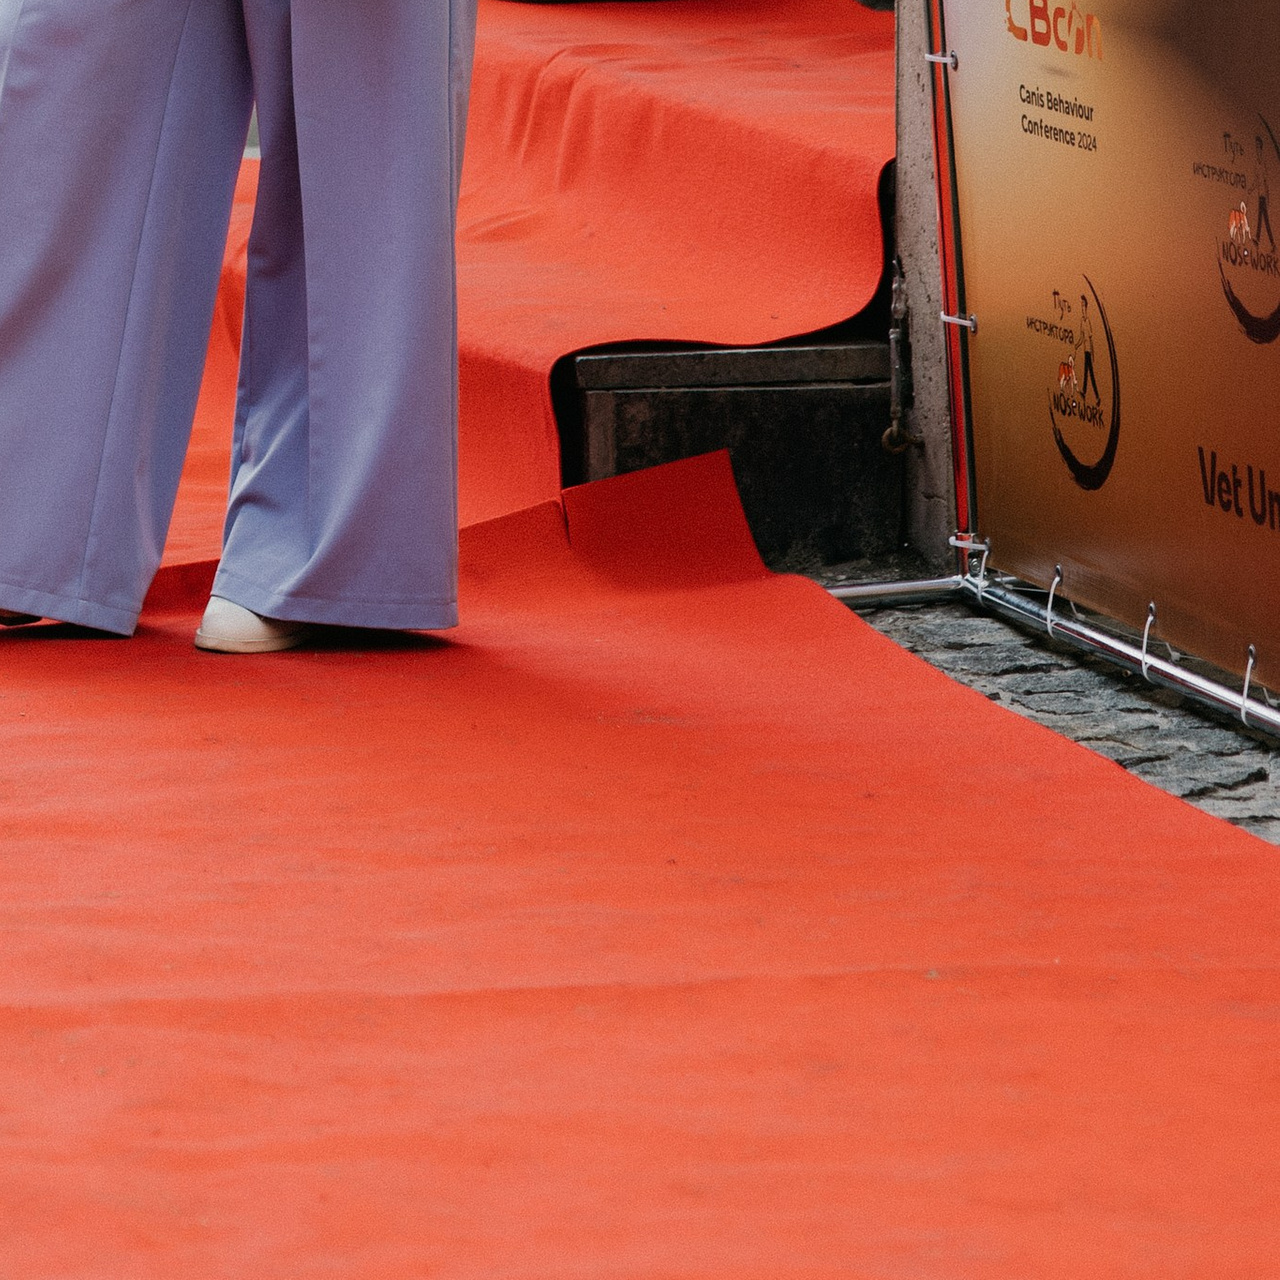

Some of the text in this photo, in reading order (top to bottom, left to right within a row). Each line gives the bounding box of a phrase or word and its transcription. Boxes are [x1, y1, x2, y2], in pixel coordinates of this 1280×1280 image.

[1019, 84, 1094, 122] Canis Behaviour
[1021, 114, 1098, 152] Conference 2024
[1198, 445, 1244, 518] Vet
